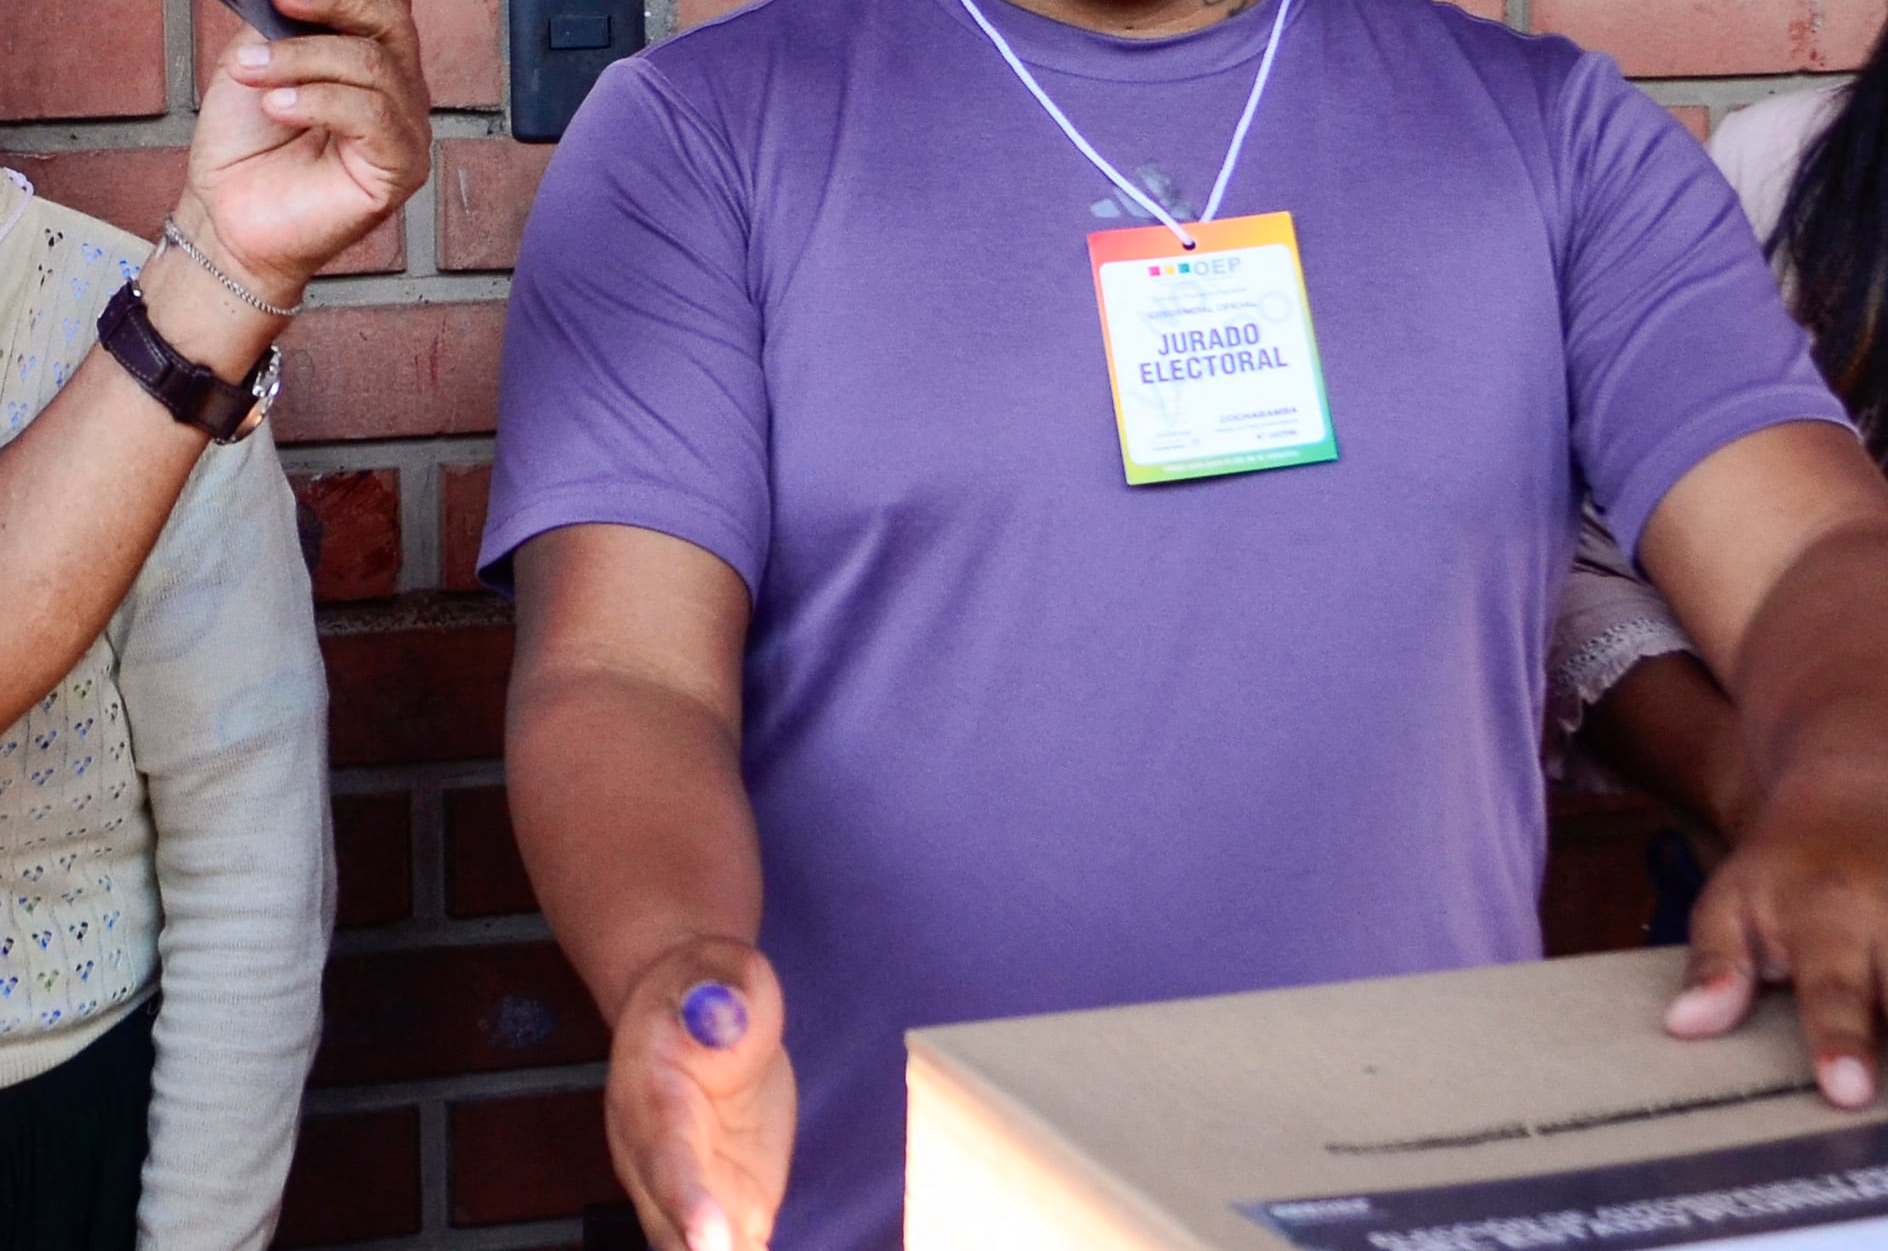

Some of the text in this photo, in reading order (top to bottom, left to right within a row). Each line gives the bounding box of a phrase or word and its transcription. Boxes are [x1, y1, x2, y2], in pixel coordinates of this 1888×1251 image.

[1194, 257, 1241, 276] OEP
[1158, 323, 1259, 356] JURADO
[1139, 346, 1289, 384] ELECTORAL
